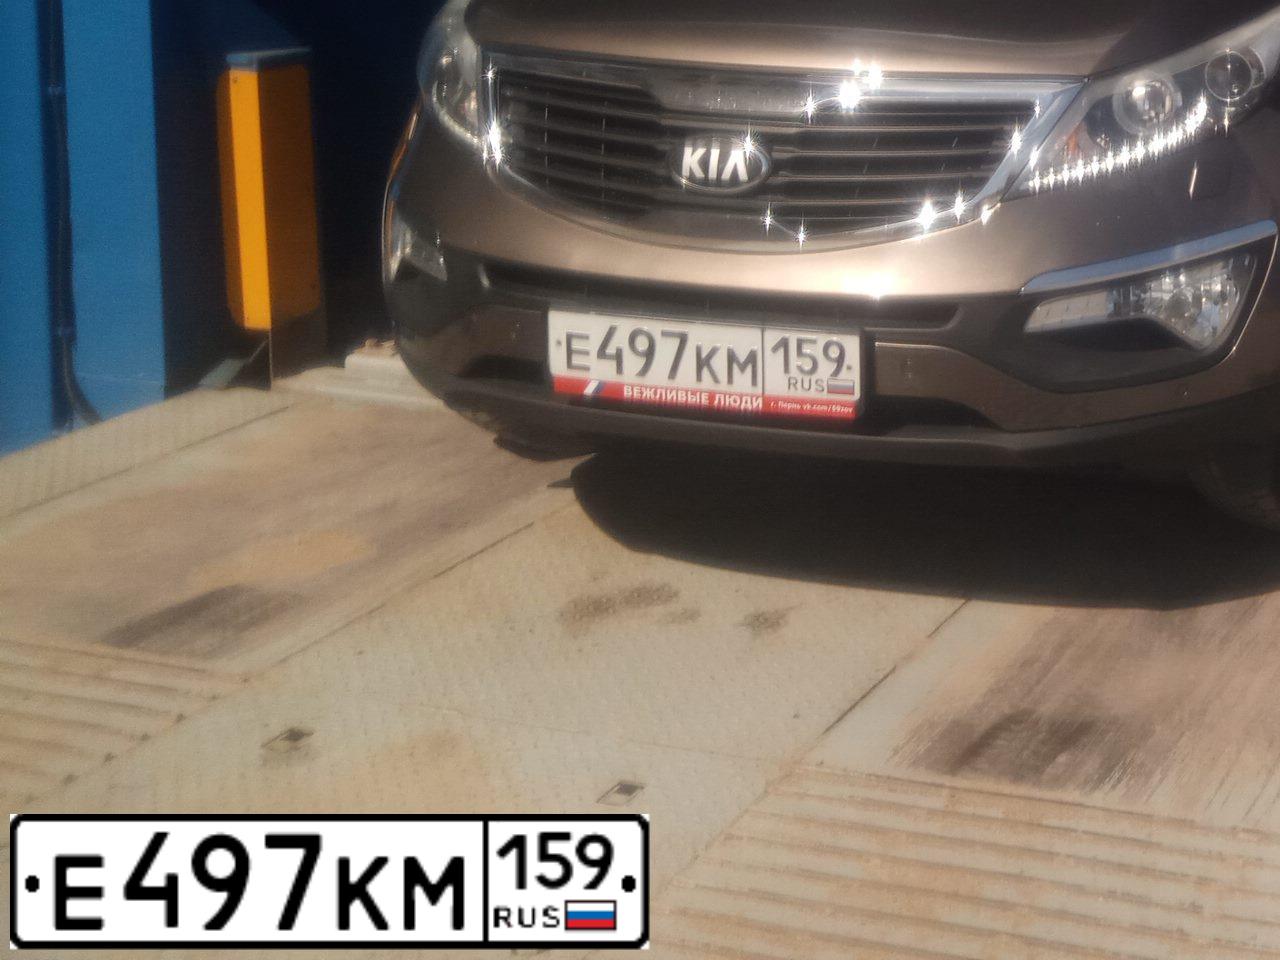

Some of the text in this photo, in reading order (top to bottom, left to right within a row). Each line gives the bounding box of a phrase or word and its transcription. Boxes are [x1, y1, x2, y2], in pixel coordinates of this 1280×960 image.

[681, 141, 749, 182] KIA
[769, 334, 847, 378] 159
[622, 383, 763, 410] ВЕЖЛИВЫЕ ЛЮДИ
[787, 376, 825, 393] RUS
